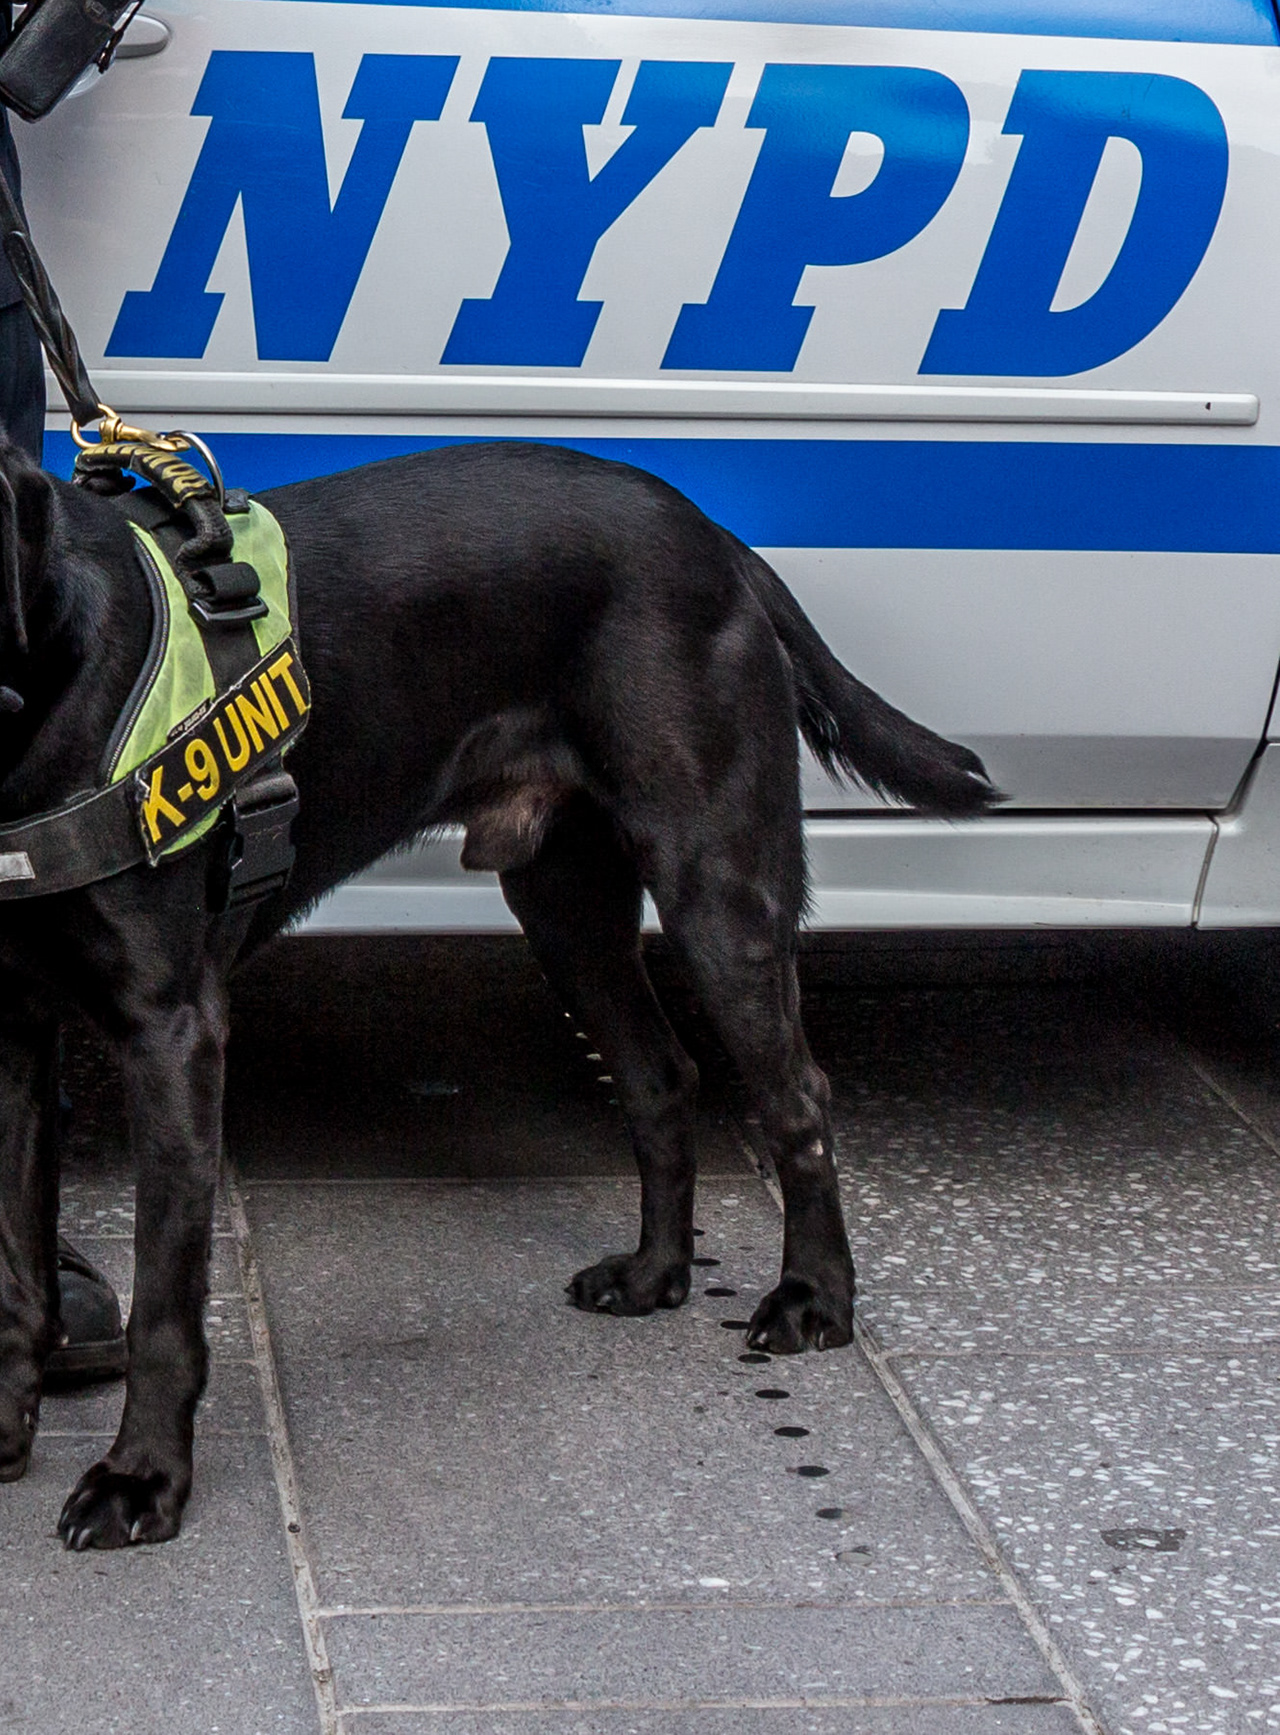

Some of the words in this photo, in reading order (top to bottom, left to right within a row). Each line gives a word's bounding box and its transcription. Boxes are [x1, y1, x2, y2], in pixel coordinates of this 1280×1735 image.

[104, 50, 1230, 378] NYPD
[143, 738, 220, 845] K-9
[212, 652, 307, 772] UNIT
